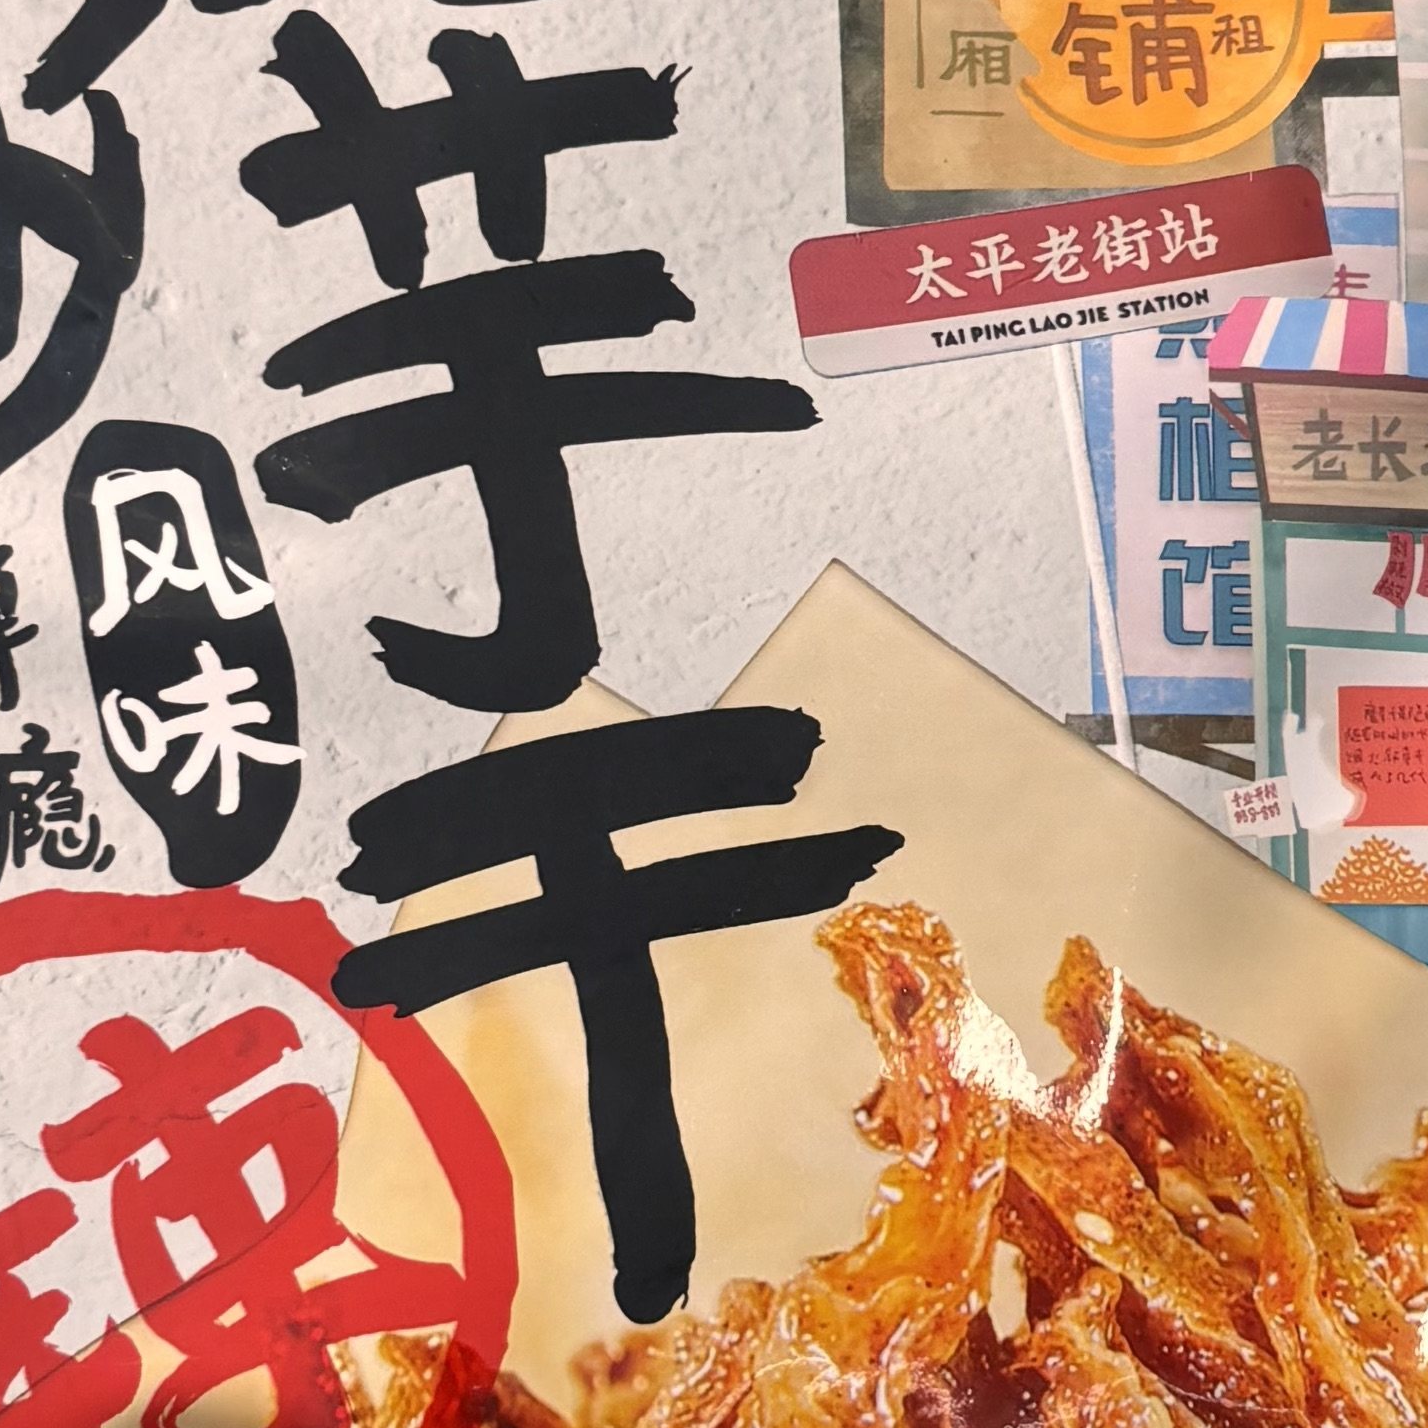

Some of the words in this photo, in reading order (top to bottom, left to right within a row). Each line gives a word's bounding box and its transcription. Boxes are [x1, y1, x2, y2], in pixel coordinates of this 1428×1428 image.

[904, 203, 1220, 304] 太平老街站
[931, 328, 966, 348] TAI
[971, 319, 1026, 343] PING
[1029, 312, 1073, 334] LAO
[1076, 306, 1109, 326] JIE
[1117, 288, 1210, 320] STATION
[1155, 317, 1262, 647] 相馆
[91, 470, 306, 815] 风味
